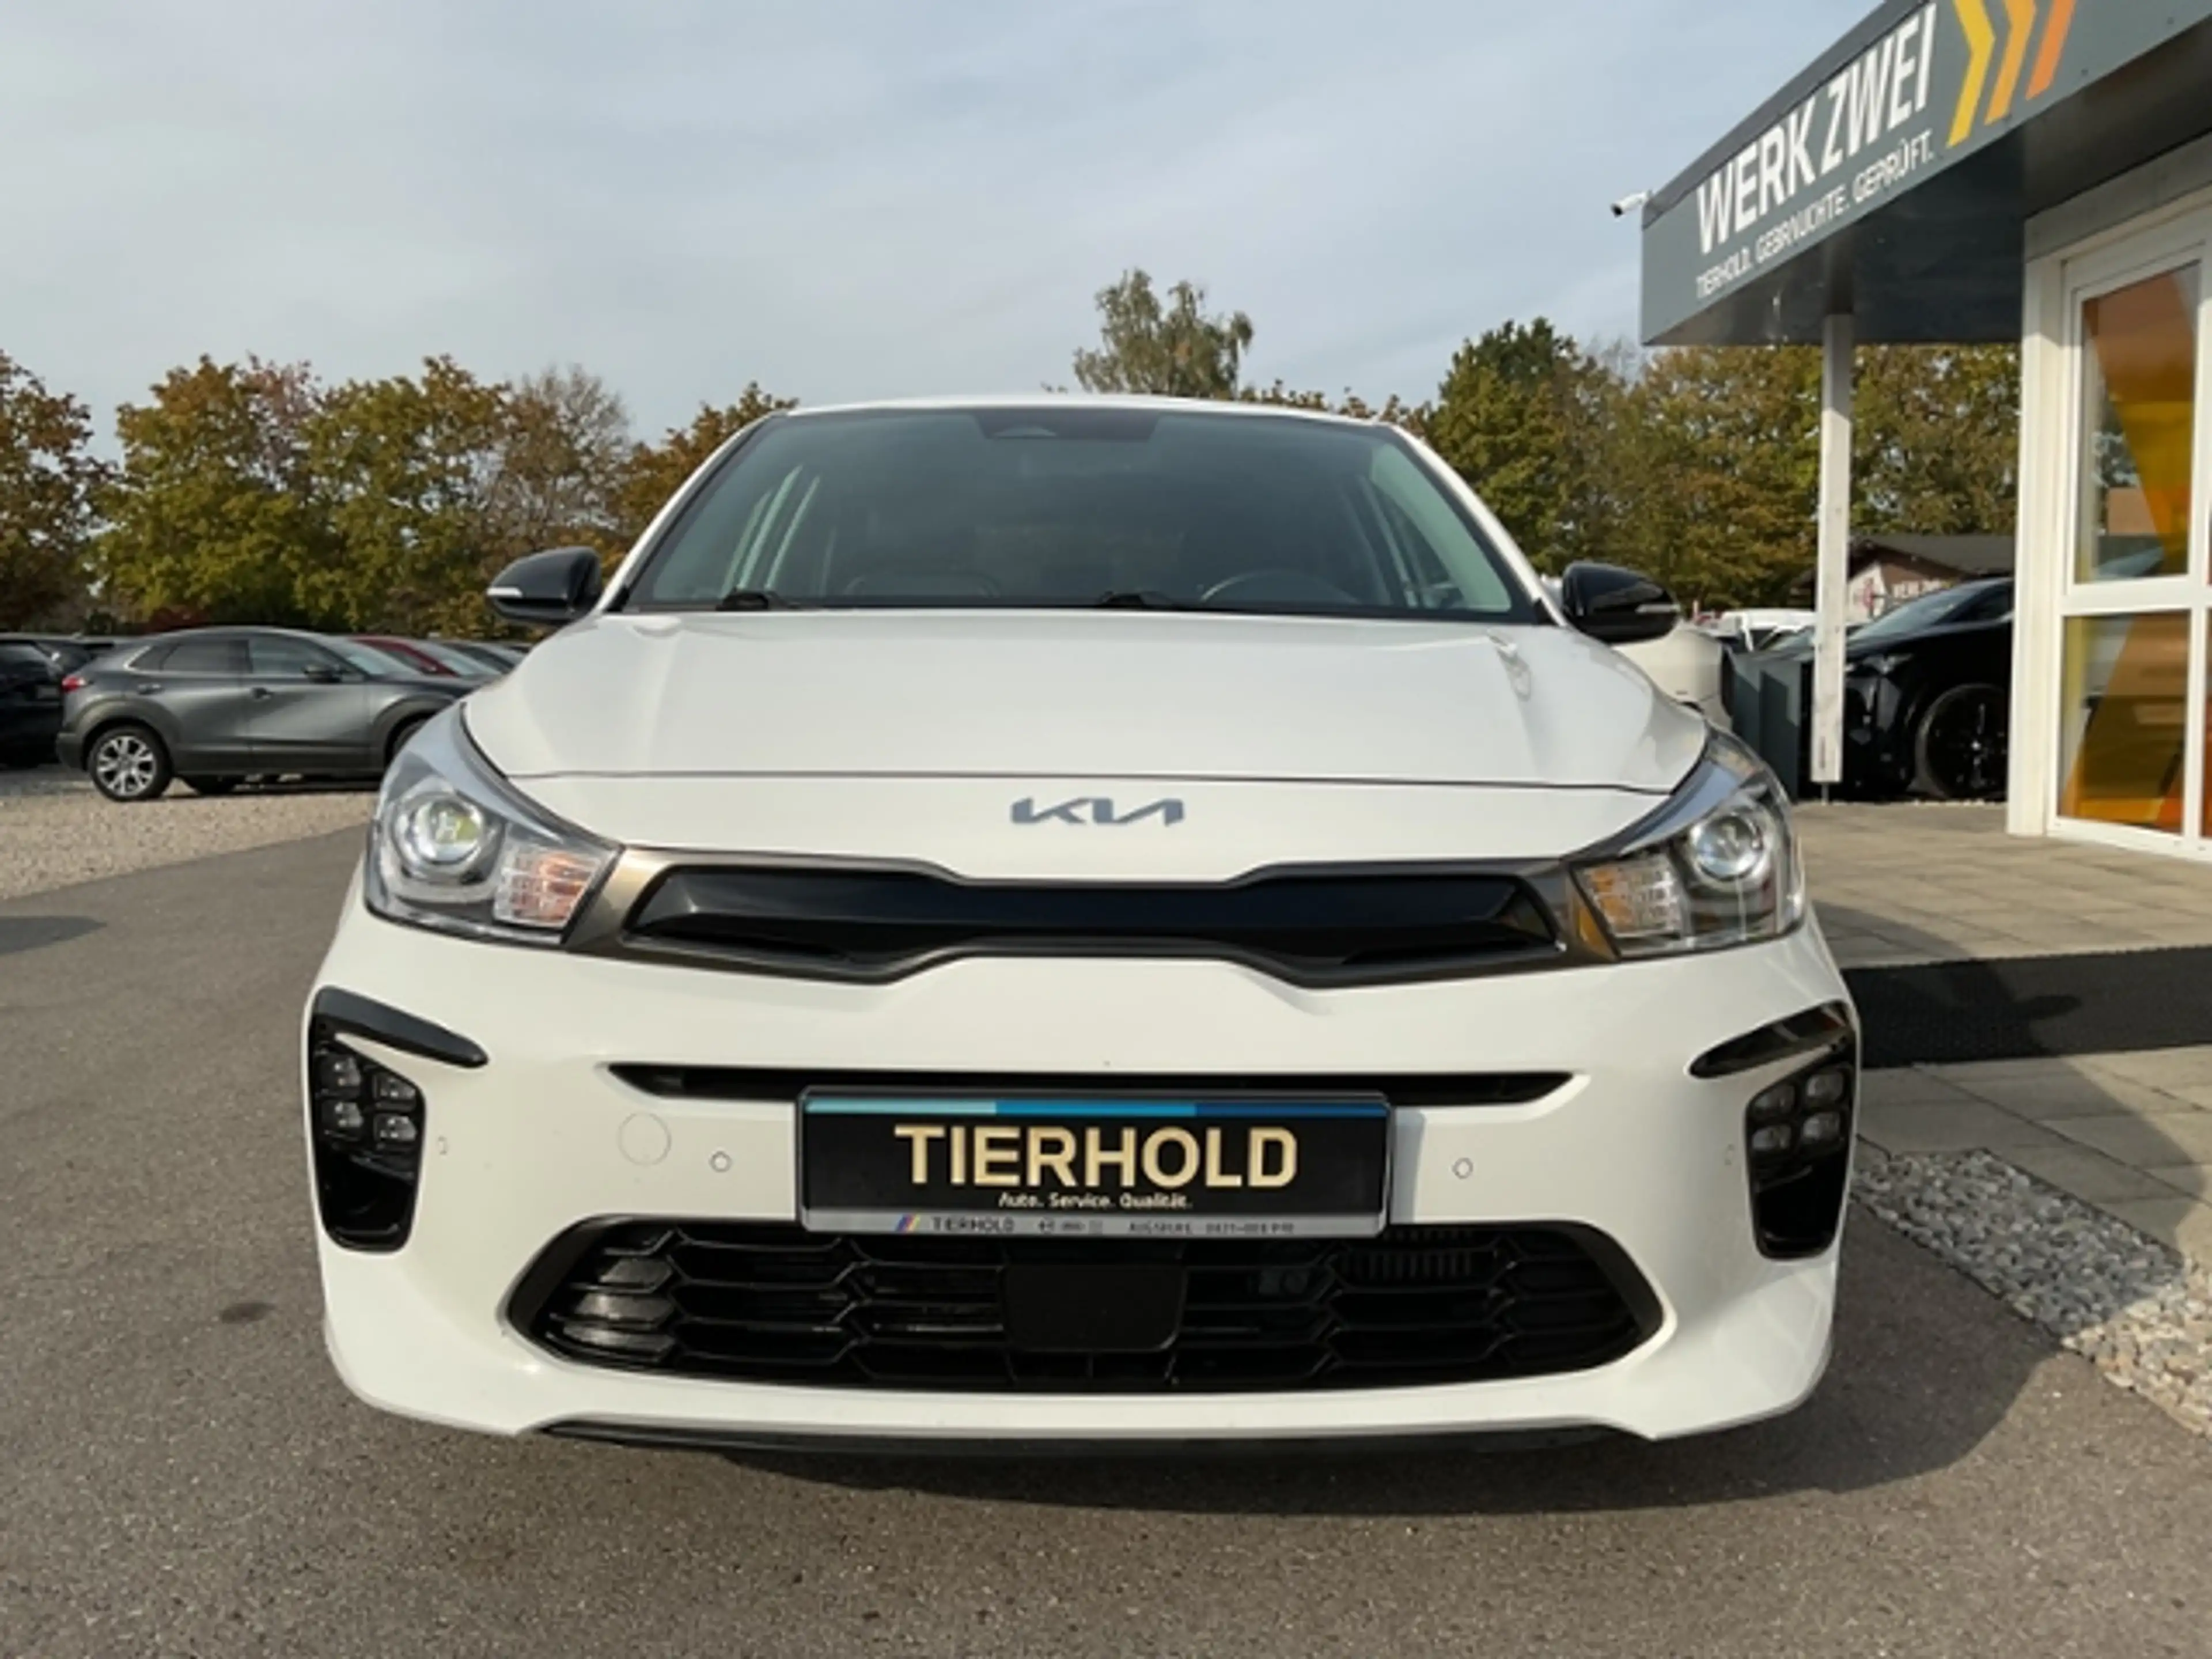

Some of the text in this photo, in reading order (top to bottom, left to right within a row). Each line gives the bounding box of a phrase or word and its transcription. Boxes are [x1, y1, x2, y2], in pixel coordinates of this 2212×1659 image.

[1696, 2, 1937, 255] WERK ZWEI
[1853, 128, 1934, 203] GEPRÜFT.
[1010, 796, 1184, 827] KIA
[893, 1124, 1297, 1188] TIERHOLD
[998, 1191, 1044, 1209] Auto.
[1048, 1191, 1116, 1209] Service.
